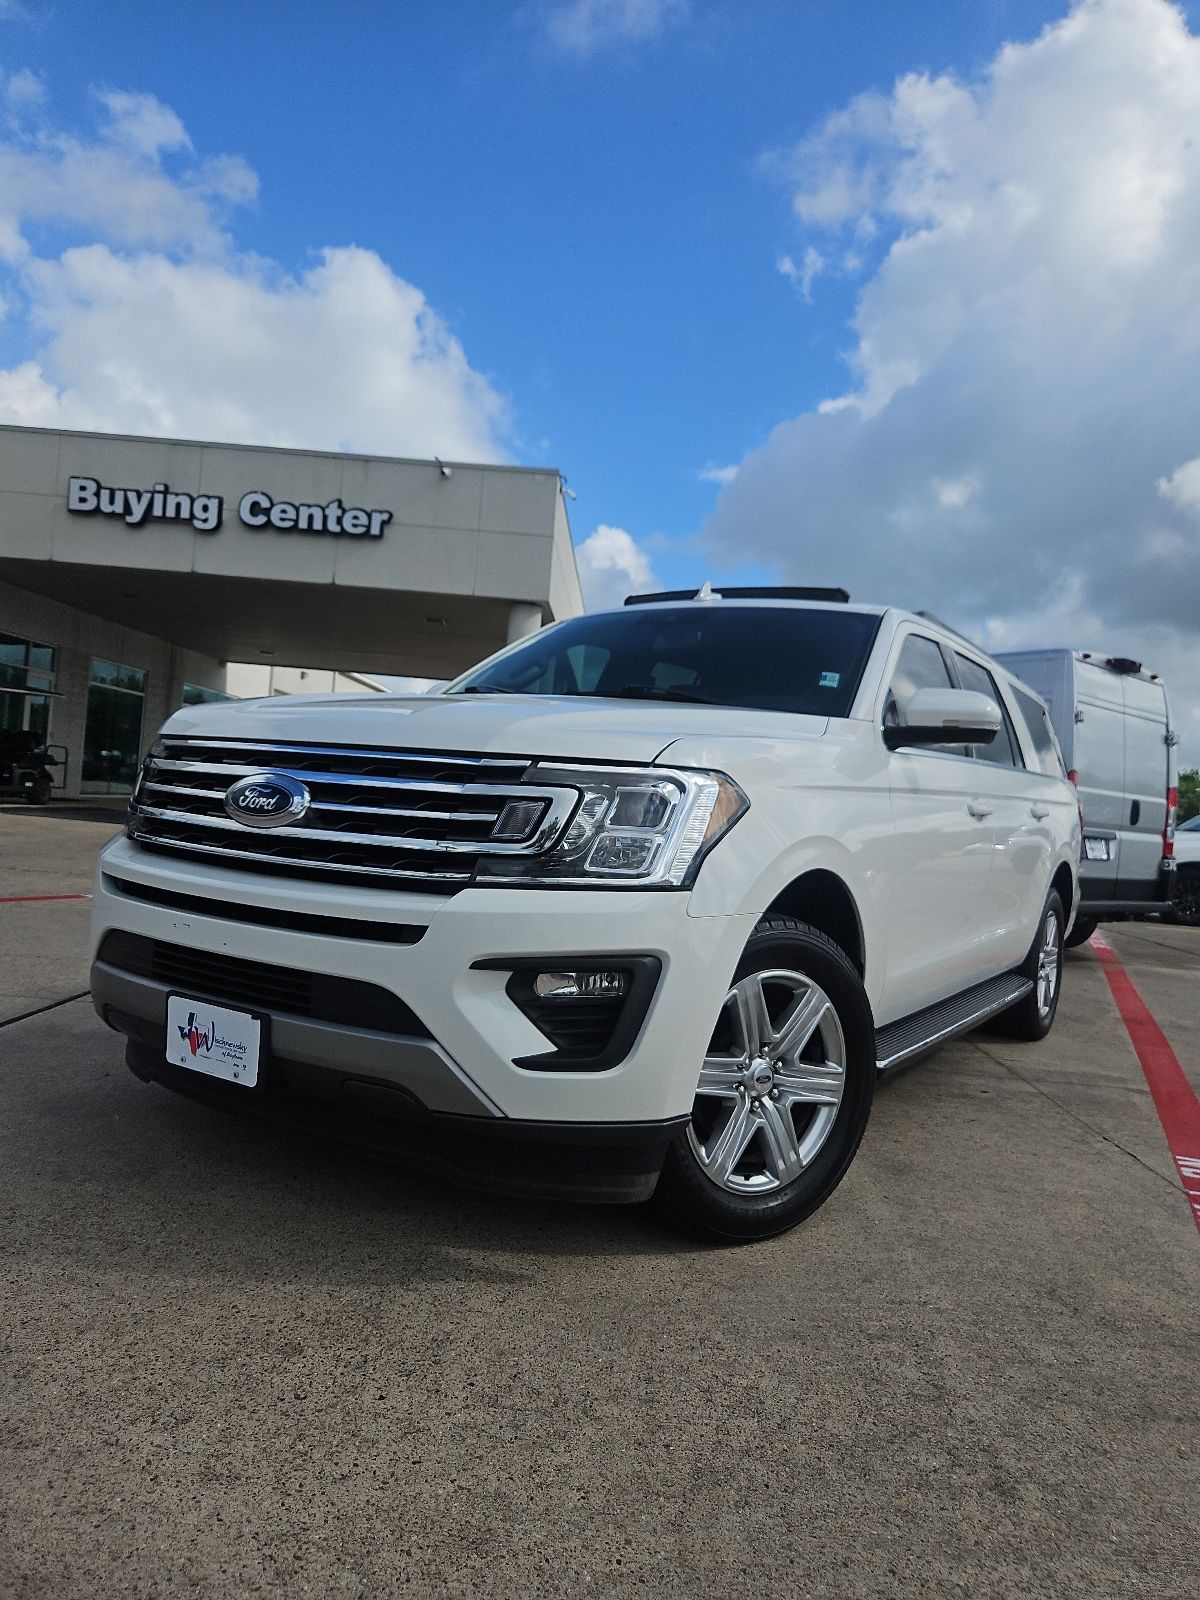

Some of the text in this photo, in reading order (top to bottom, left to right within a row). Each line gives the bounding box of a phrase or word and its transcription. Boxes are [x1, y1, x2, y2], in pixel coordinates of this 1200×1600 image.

[68, 476, 393, 539] Buying Center
[238, 785, 280, 811] Ford
